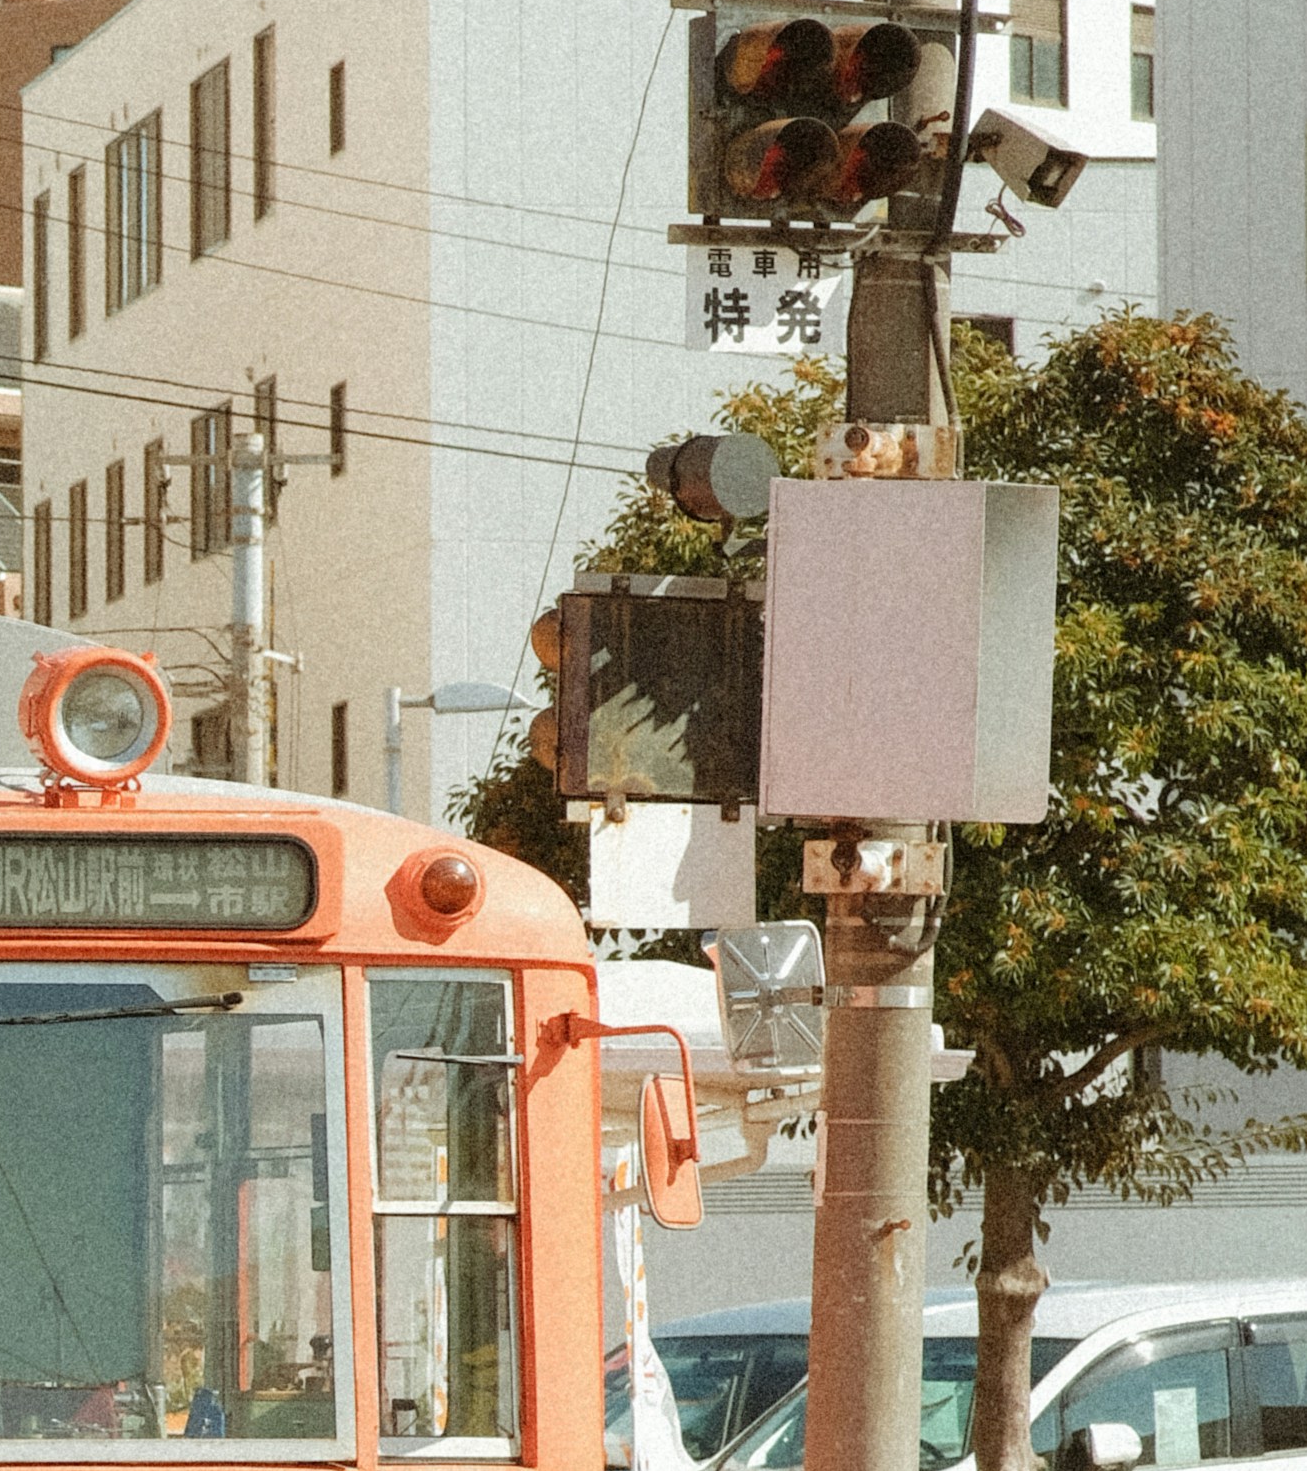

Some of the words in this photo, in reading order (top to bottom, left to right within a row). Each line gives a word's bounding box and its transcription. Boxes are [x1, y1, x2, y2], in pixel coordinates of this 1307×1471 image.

[707, 248, 821, 280] 電車用
[703, 287, 822, 344] 特発
[206, 847, 291, 879] 松山
[206, 884, 290, 917] 市駅
